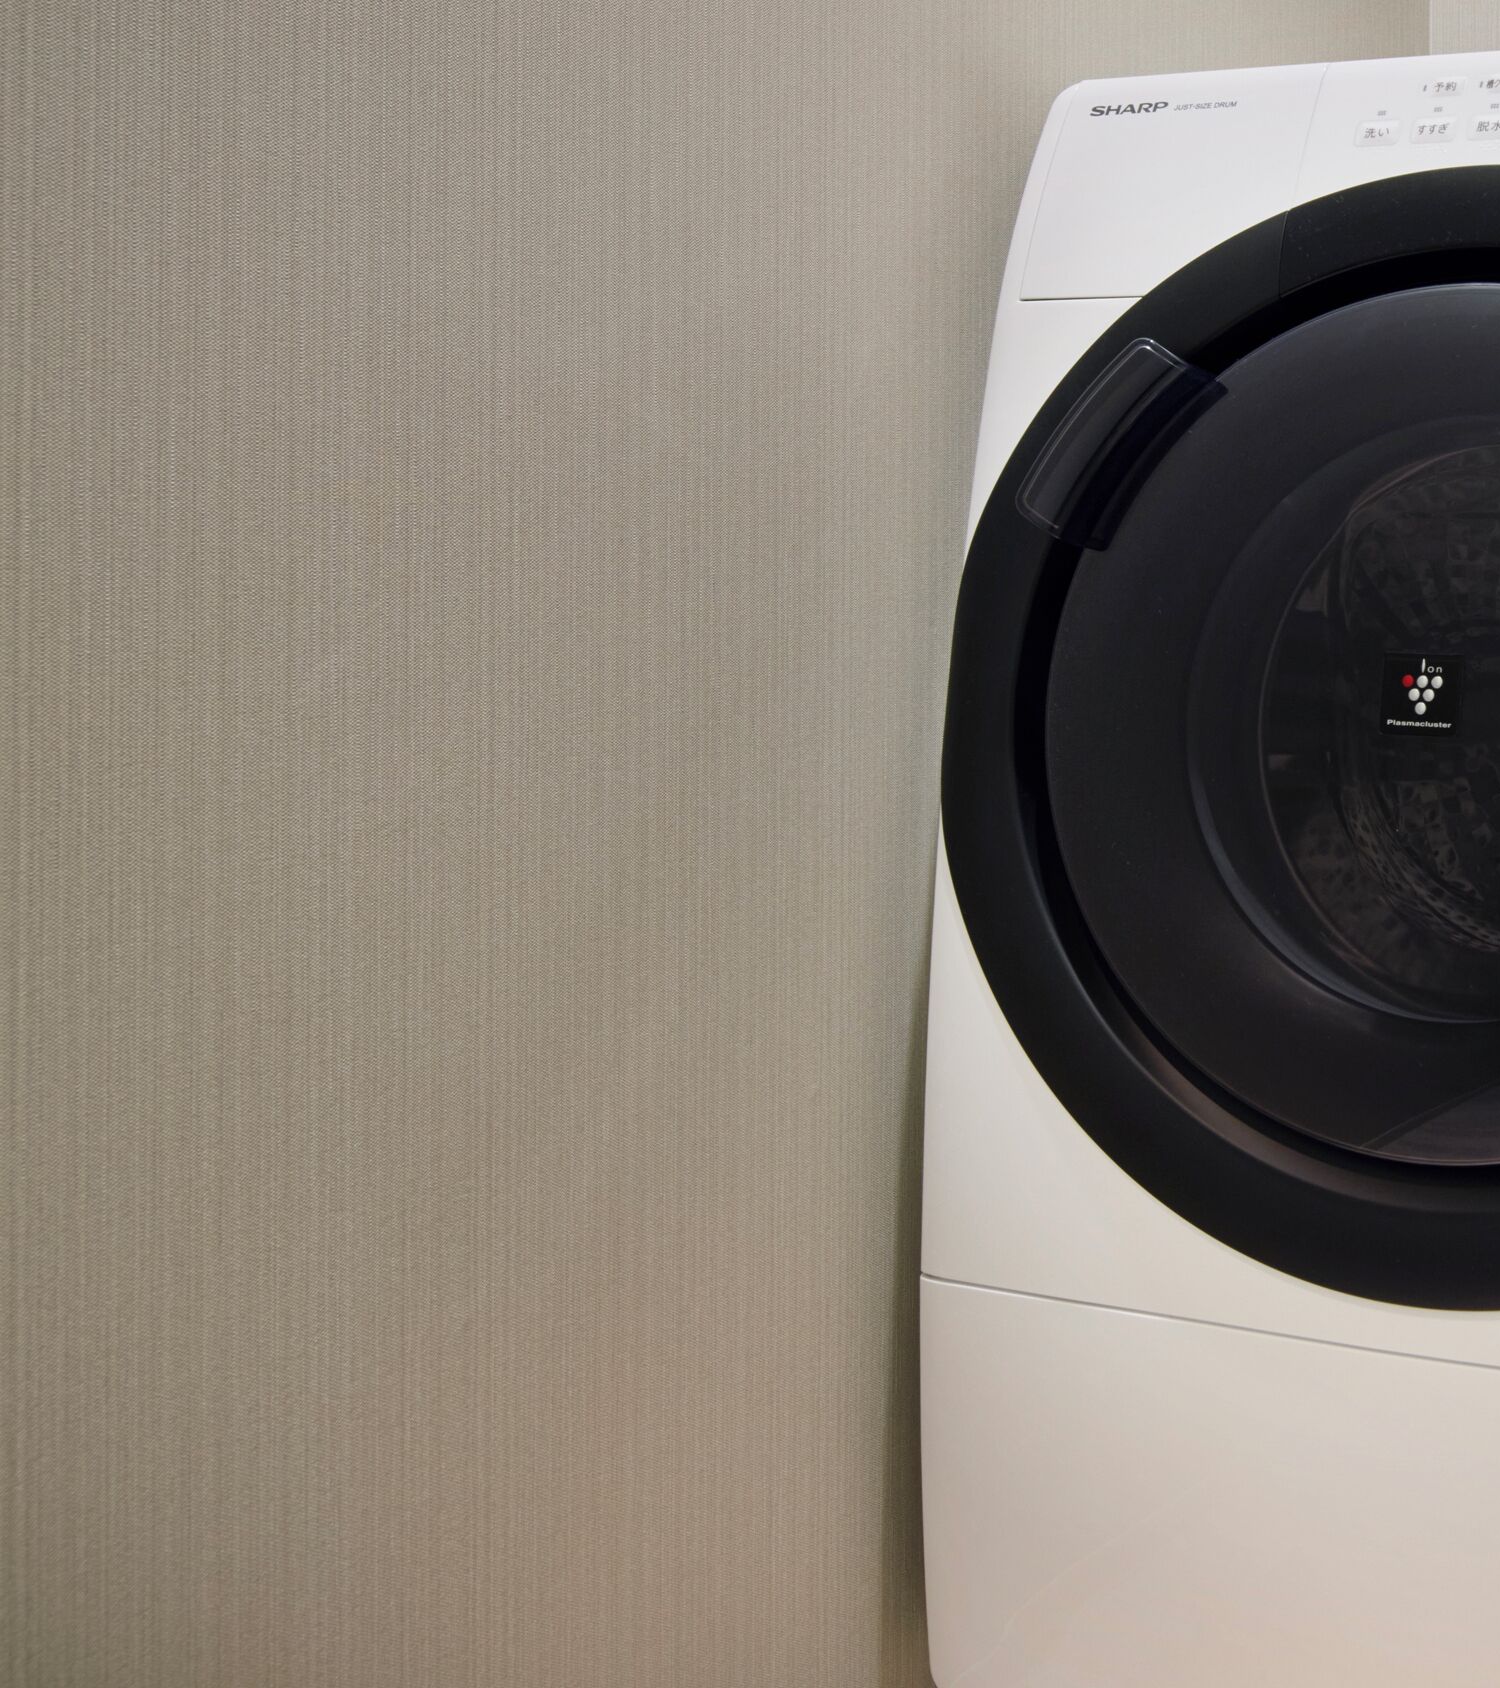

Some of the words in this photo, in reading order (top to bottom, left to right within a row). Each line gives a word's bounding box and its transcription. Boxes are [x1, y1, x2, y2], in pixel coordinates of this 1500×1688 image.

[1434, 81, 1457, 92] 予約
[1090, 101, 1169, 117] SHARP
[1174, 102, 1212, 111] JUST-SIZE
[1214, 101, 1238, 109] DRUM
[1364, 127, 1389, 139] 洗い
[1418, 122, 1450, 135] すすぎ
[1421, 658, 1443, 673] Ion
[1386, 719, 1452, 728] Plasmacluster
